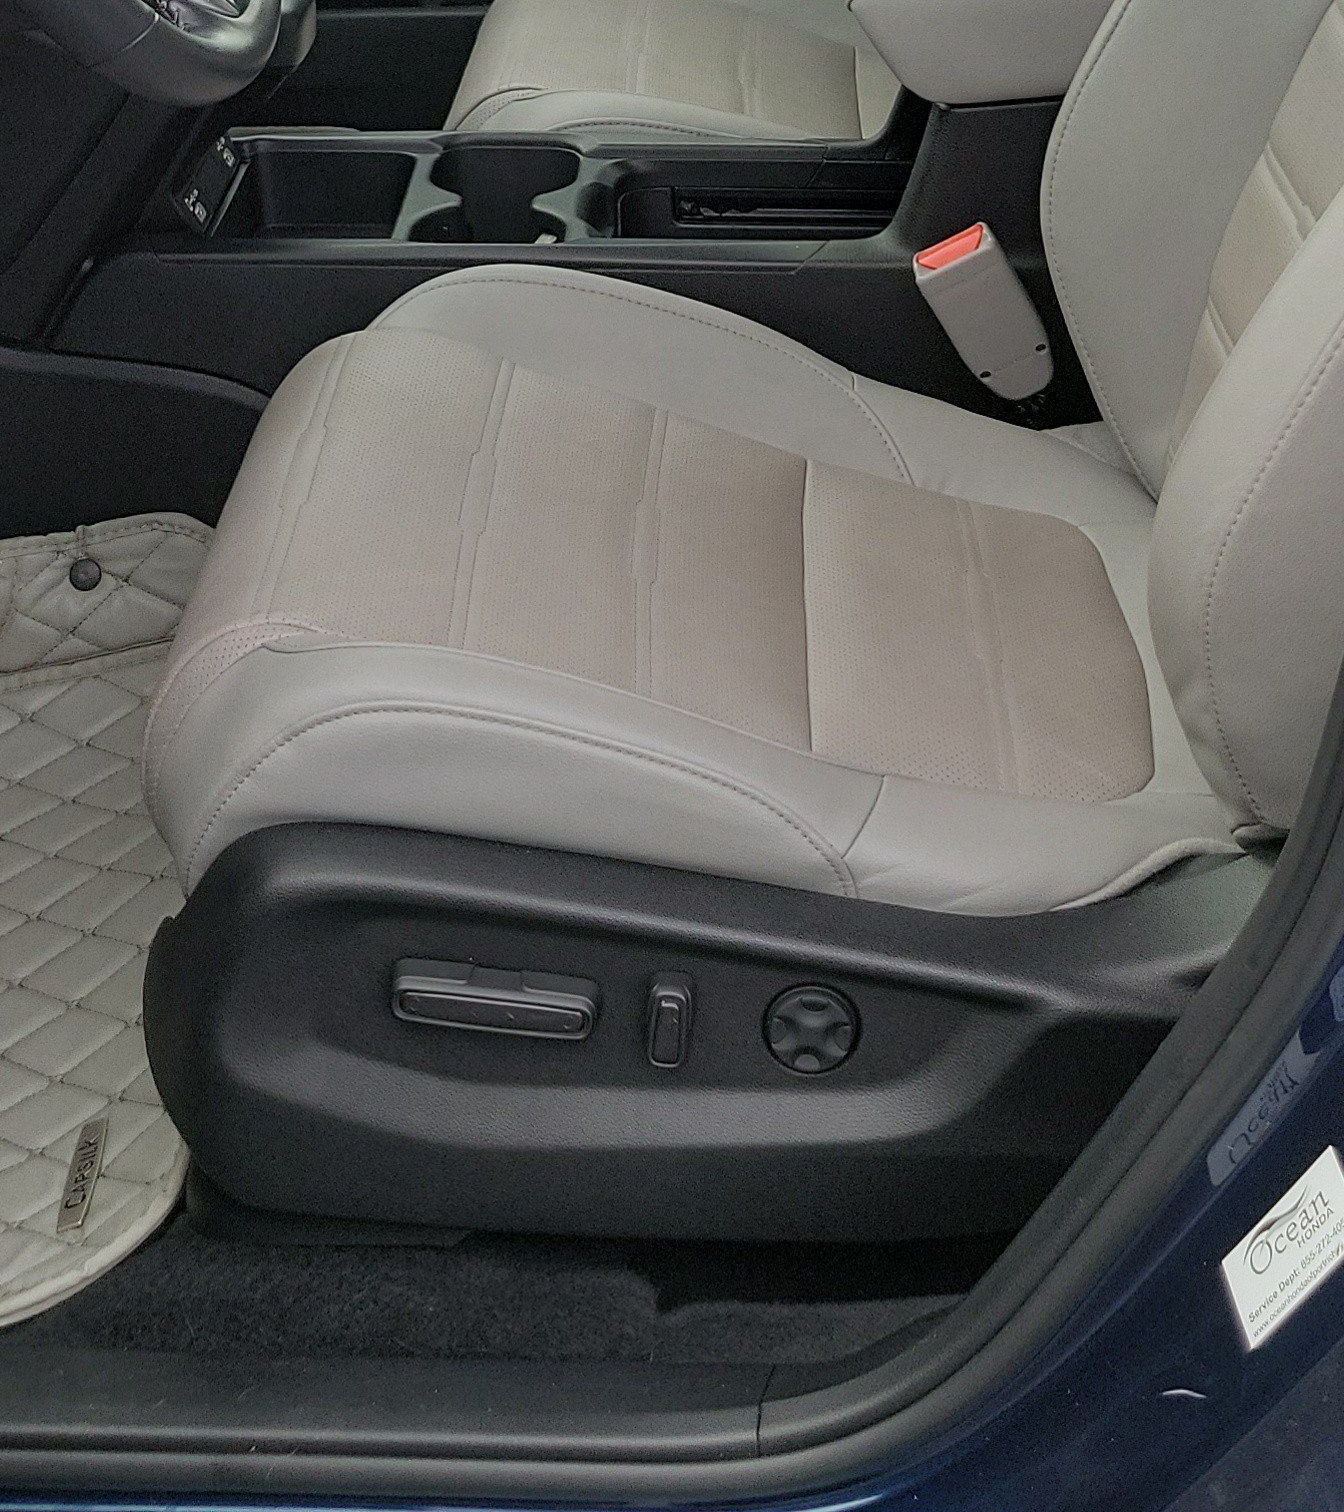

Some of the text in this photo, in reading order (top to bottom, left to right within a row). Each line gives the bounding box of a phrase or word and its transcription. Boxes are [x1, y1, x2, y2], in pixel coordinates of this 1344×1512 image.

[1246, 1187, 1330, 1280] Ocean
[1296, 1204, 1334, 1248] HONDA
[1247, 1289, 1278, 1324] Service
